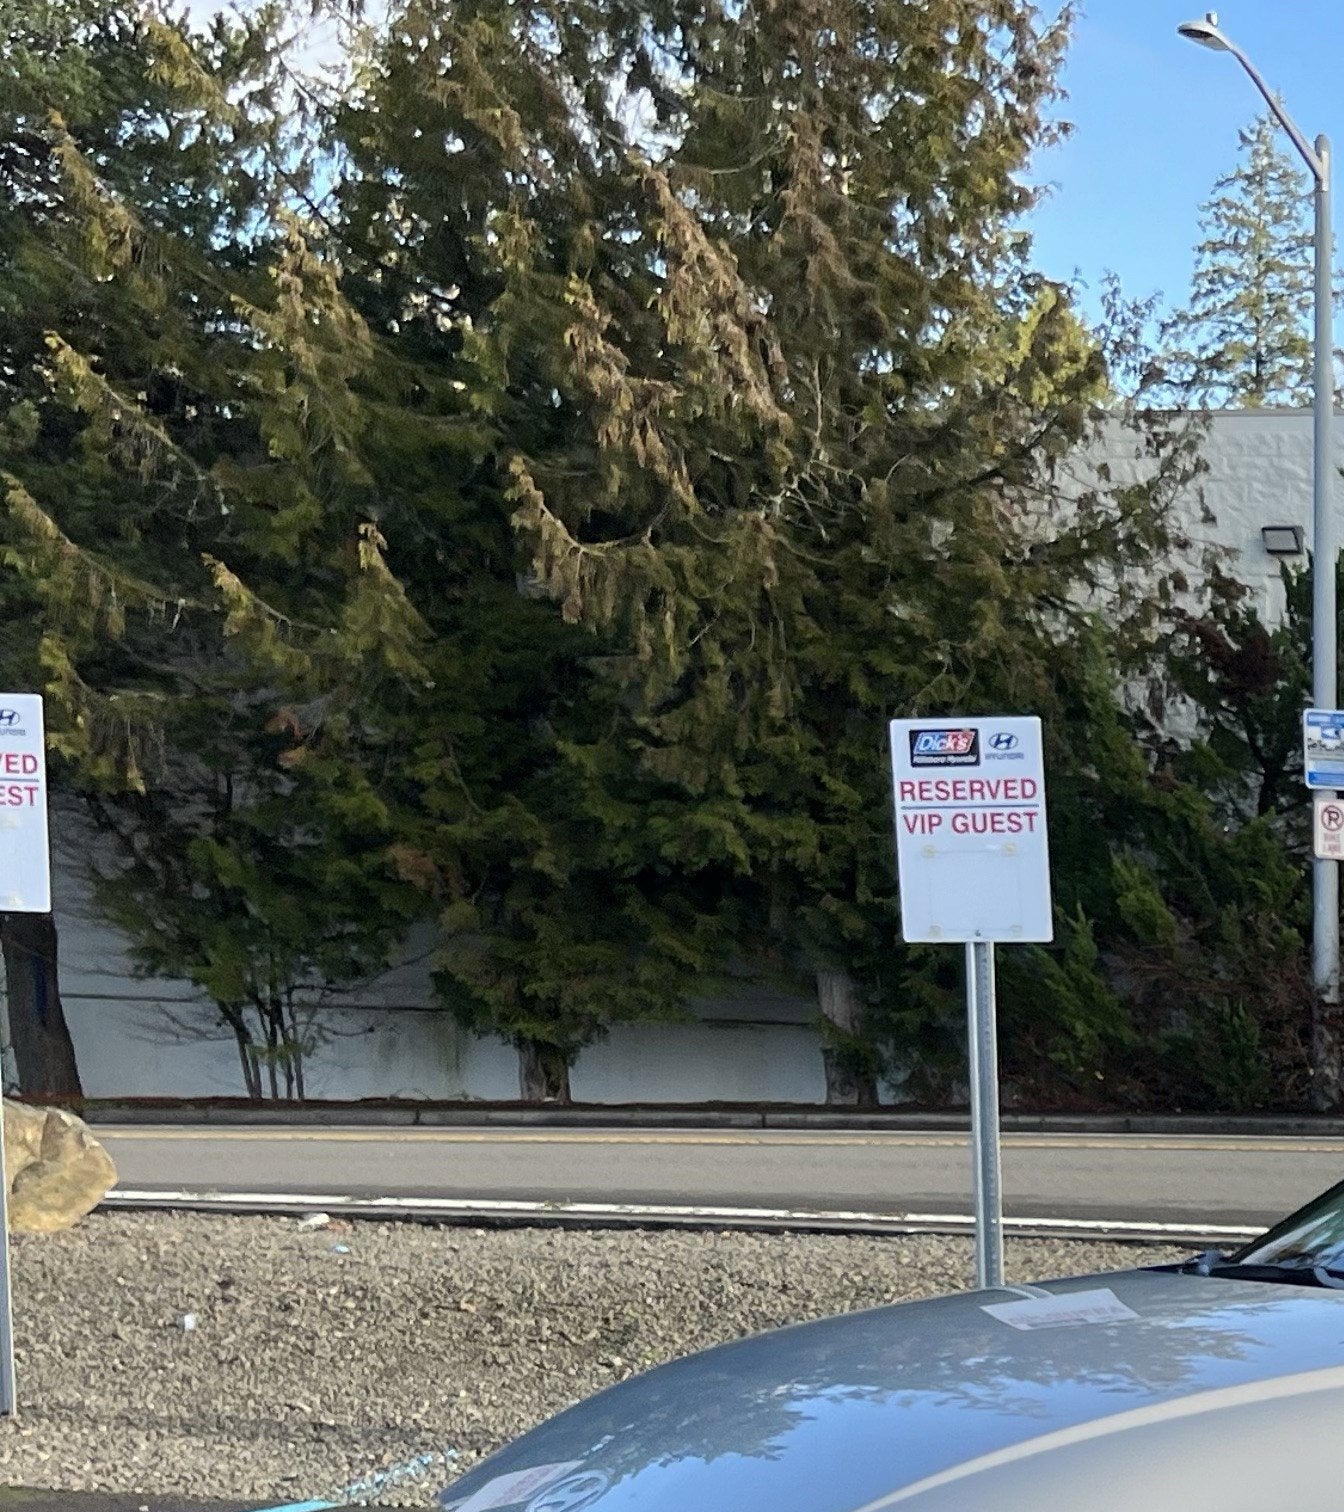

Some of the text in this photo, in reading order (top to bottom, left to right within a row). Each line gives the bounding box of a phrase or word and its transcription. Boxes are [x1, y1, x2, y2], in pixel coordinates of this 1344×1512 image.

[899, 778, 1038, 802] RESERVED
[903, 811, 1039, 835] VIP GUEST
